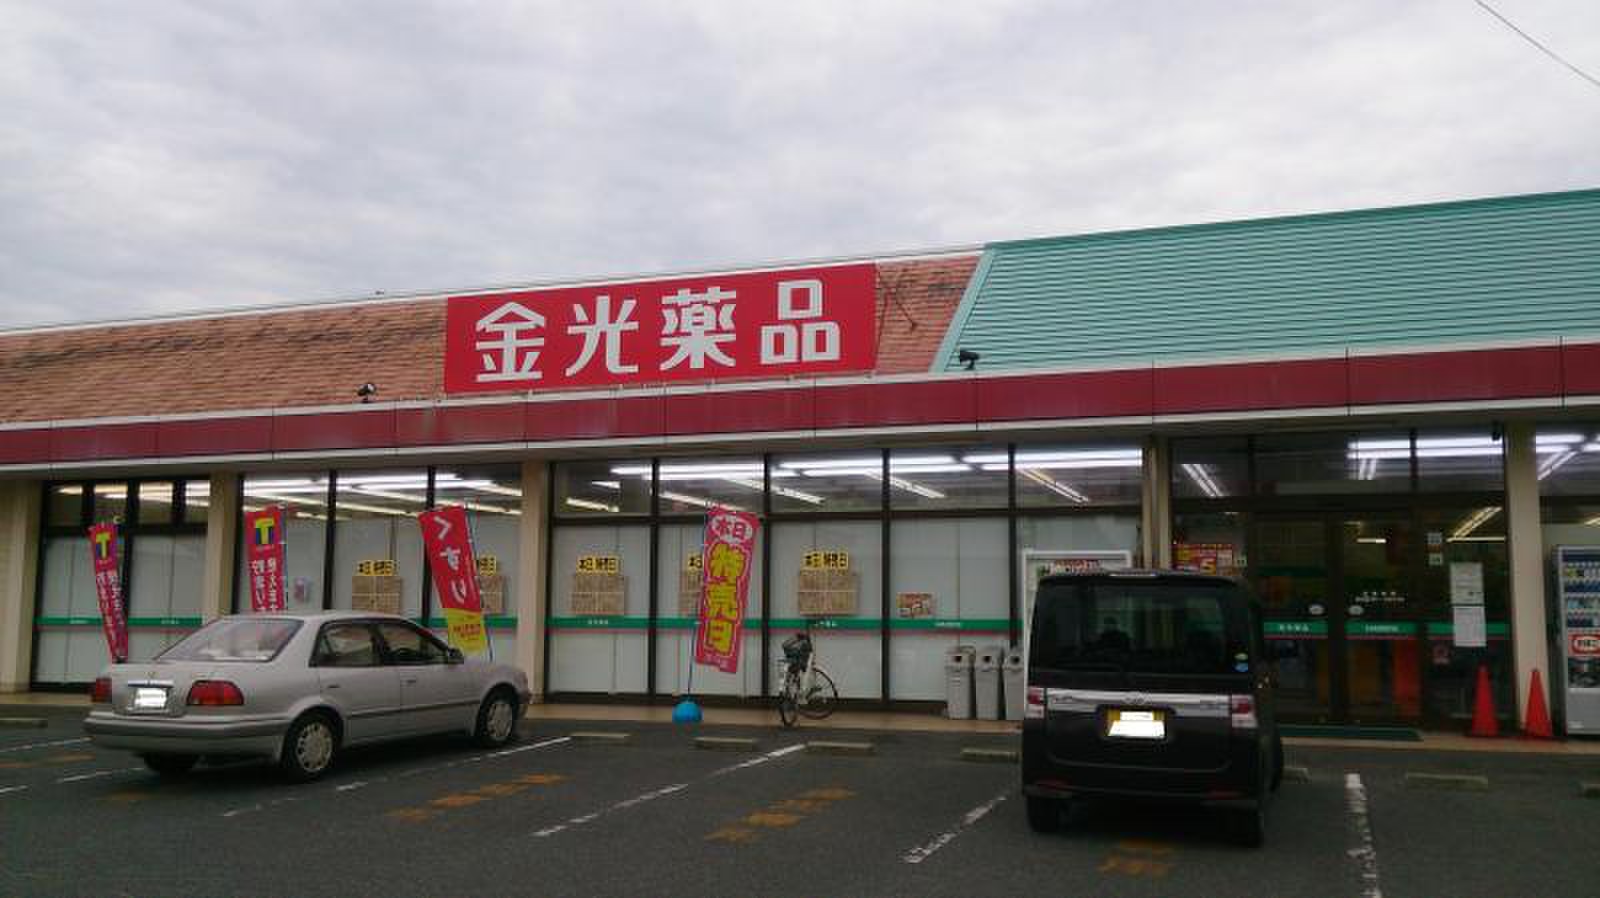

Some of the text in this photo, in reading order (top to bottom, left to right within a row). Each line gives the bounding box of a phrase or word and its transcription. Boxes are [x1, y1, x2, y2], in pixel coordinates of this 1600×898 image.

[475, 279, 841, 382] 金光薬品
[432, 515, 467, 604] くすり
[705, 542, 747, 656] 特売日
